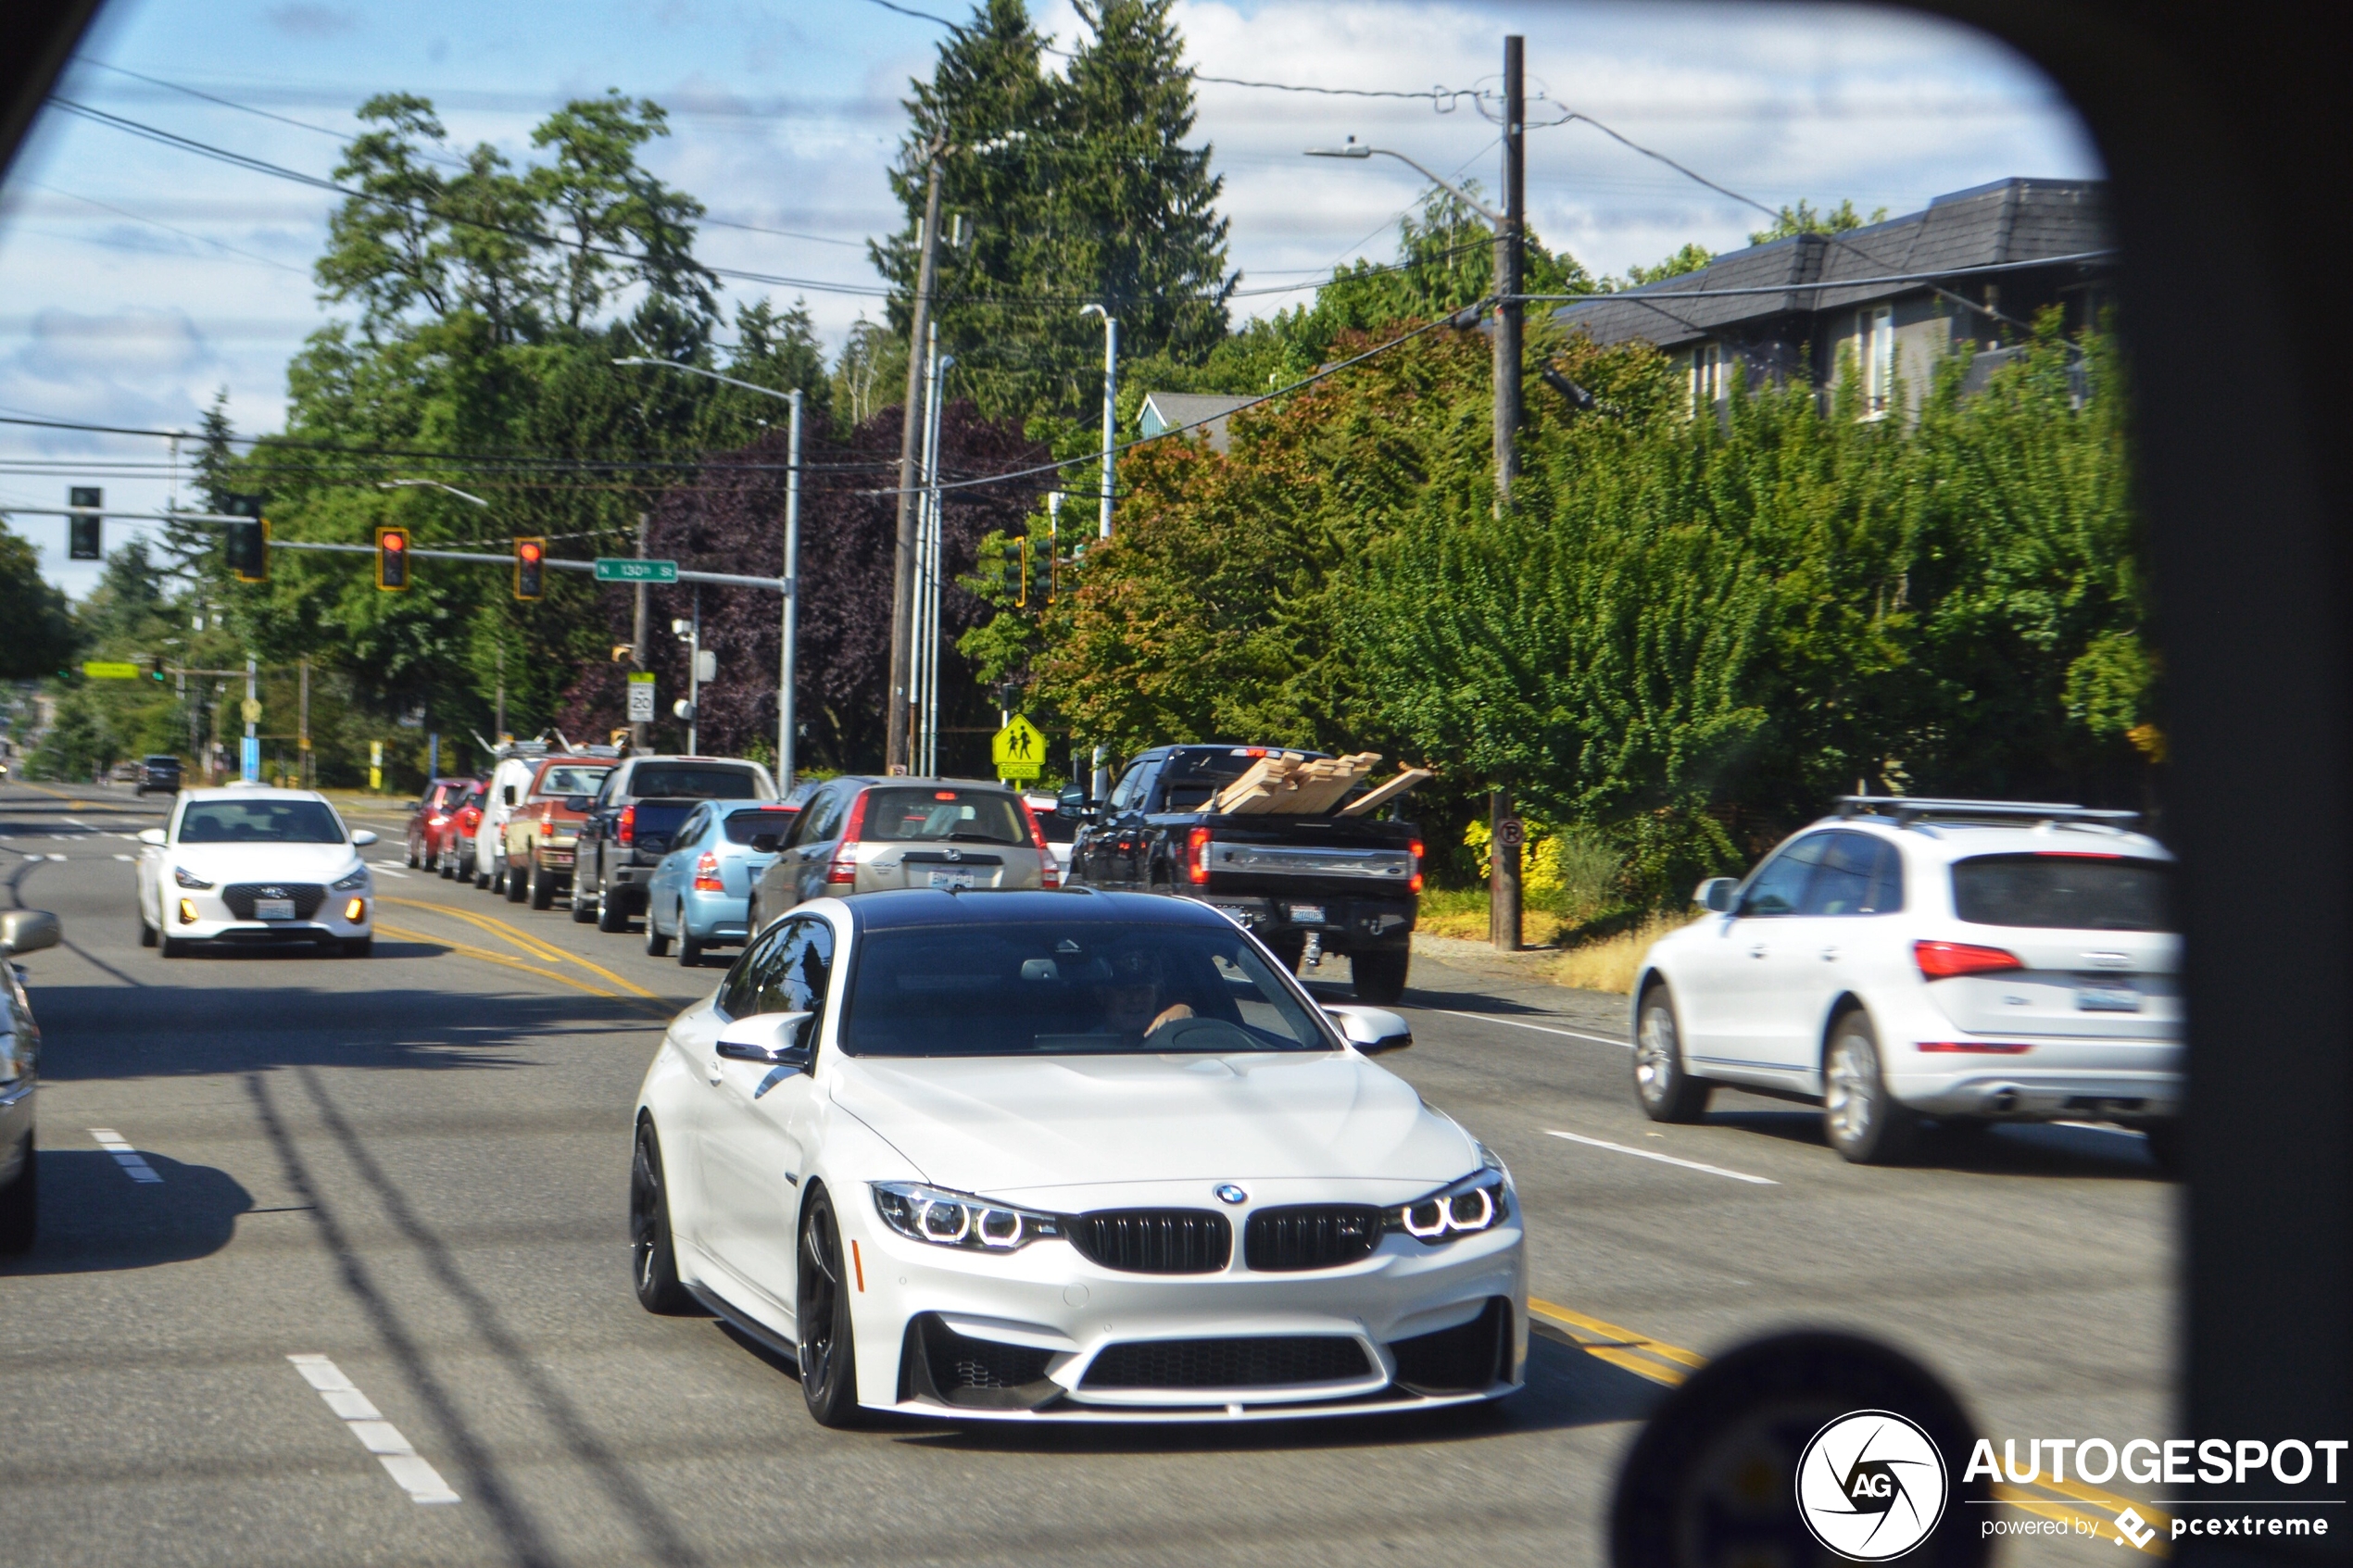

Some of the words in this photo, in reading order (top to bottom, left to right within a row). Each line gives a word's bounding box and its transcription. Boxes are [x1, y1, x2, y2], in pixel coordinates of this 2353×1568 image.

[599, 564, 610, 575] N
[621, 564, 652, 576] 130th
[660, 566, 673, 577] St
[633, 696, 652, 709] 20
[1001, 767, 1036, 775] SCHOOL
